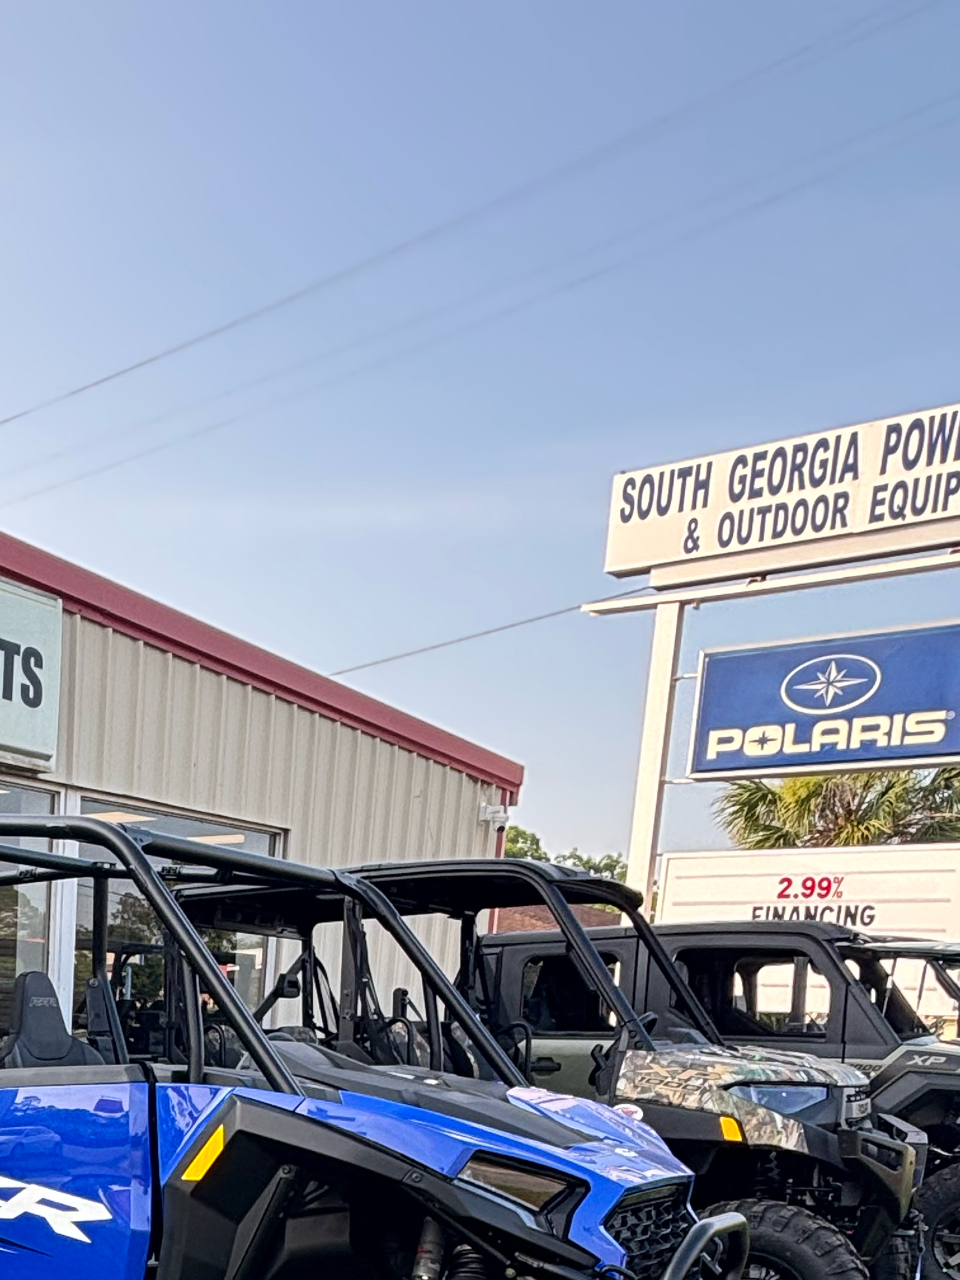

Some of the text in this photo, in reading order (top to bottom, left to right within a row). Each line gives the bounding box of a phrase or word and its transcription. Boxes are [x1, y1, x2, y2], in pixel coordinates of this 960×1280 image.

[619, 410, 960, 524] SOUTH GEORGIA POW
[683, 470, 960, 554] & OUTDOOR EQUIP
[706, 710, 948, 761] POLARIS
[776, 876, 845, 899] 2.99%
[751, 905, 876, 926] FINANCING
[906, 1054, 947, 1066] XP
[636, 1063, 721, 1081] XP
